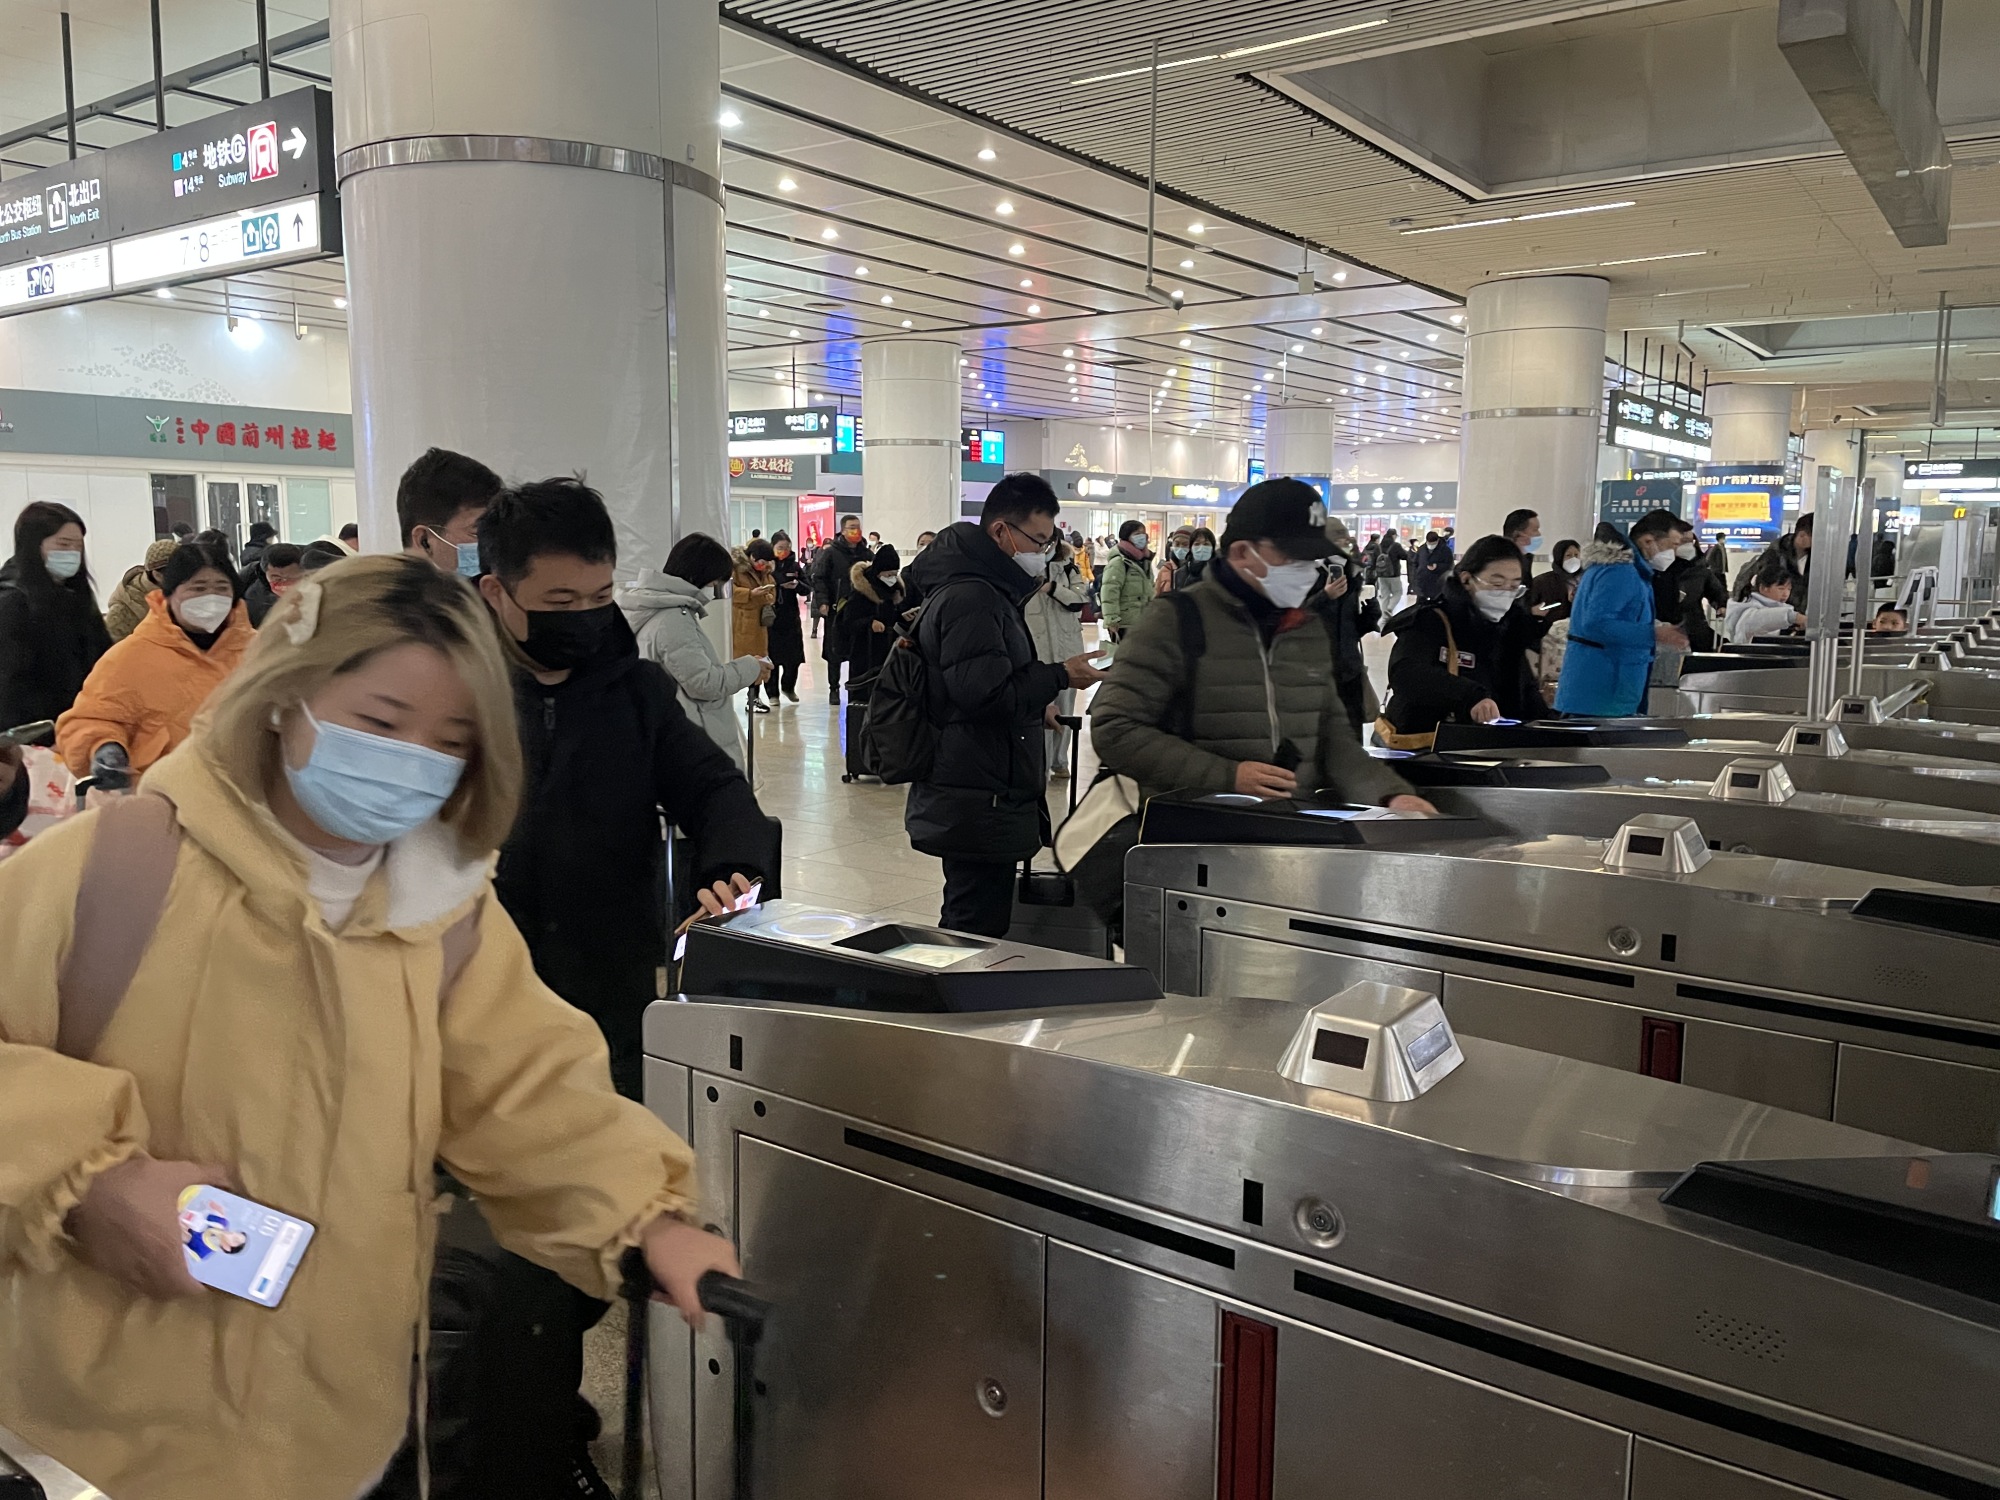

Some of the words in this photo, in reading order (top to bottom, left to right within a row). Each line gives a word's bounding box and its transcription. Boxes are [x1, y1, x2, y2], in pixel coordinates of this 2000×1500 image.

[203, 138, 232, 170] 地铁
[218, 171, 247, 188] Subway
[69, 179, 100, 207] 北出口
[70, 212, 87, 226] North
[88, 208, 100, 220] Exit
[0, 231, 10, 243] orth
[11, 230, 22, 240] Bus
[22, 224, 42, 238] Station
